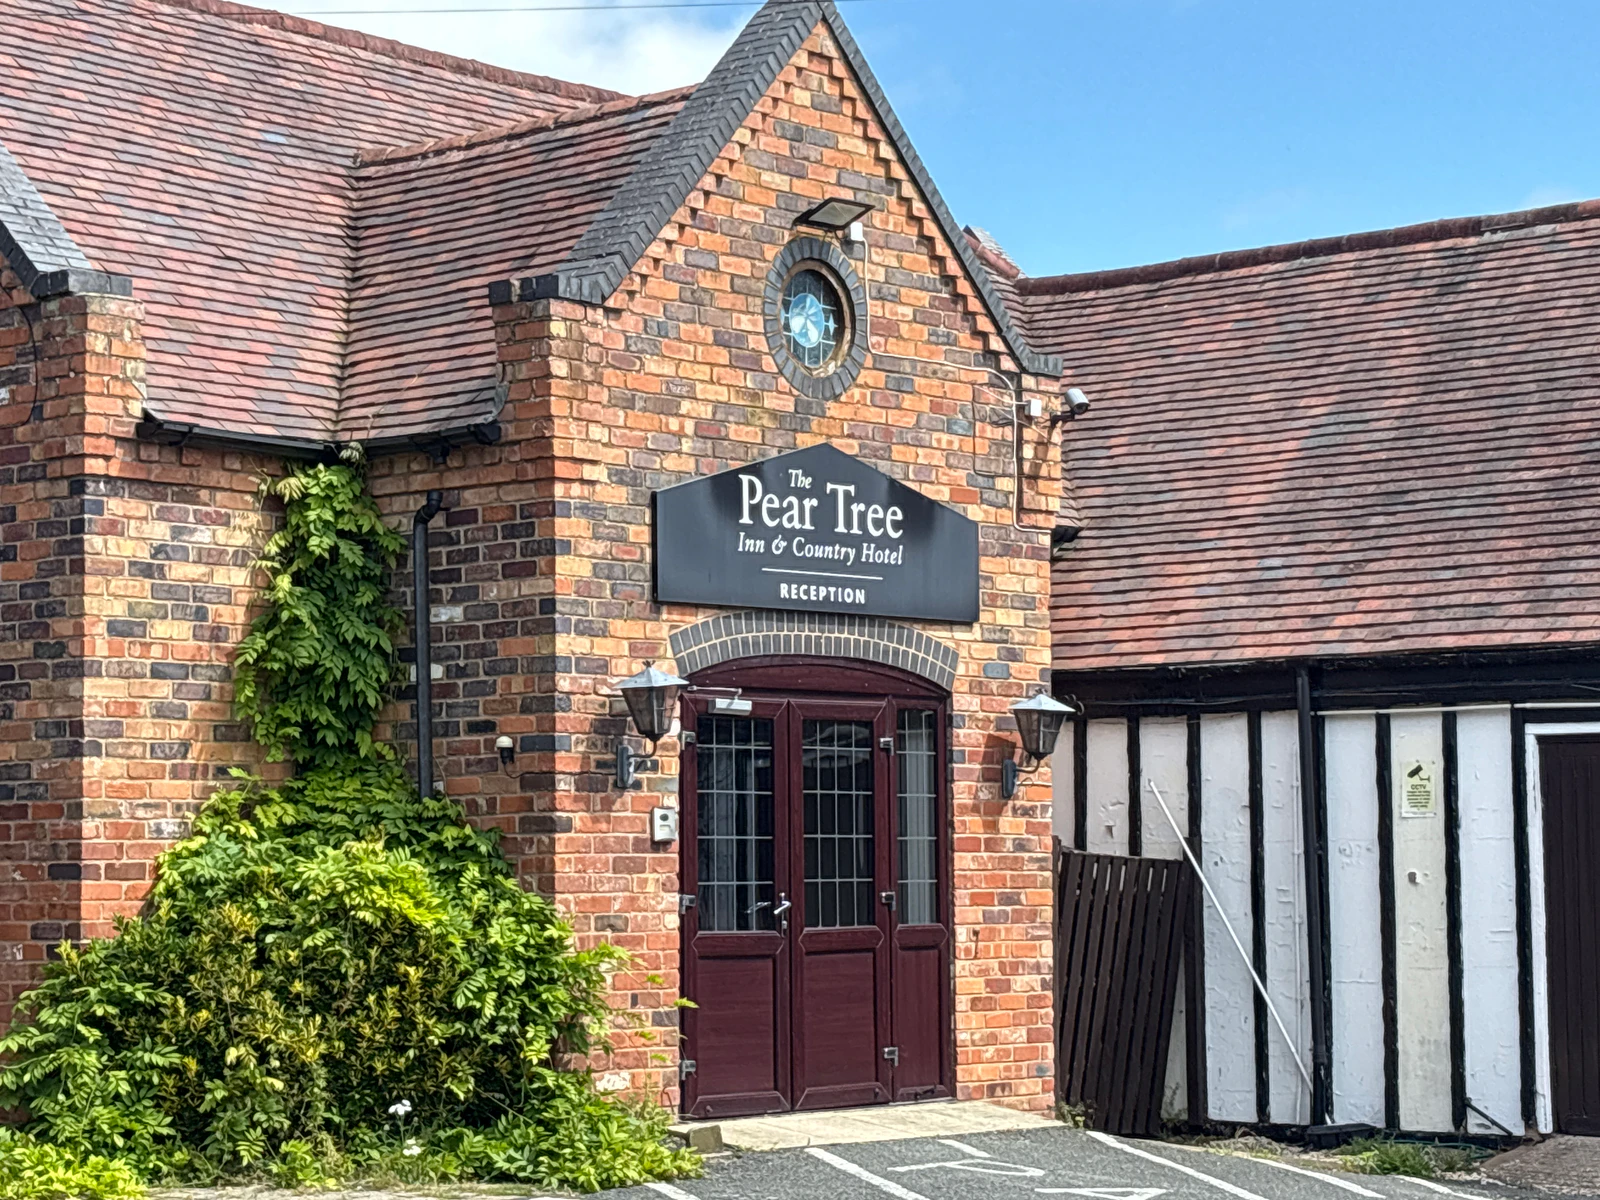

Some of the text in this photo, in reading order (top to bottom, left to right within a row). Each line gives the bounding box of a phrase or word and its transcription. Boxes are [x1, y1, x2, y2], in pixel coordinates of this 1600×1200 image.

[788, 469, 812, 490] The
[738, 474, 904, 539] Pear Tree
[737, 532, 904, 566] Inn & Country Hotel
[779, 582, 866, 605] RECEPTION
